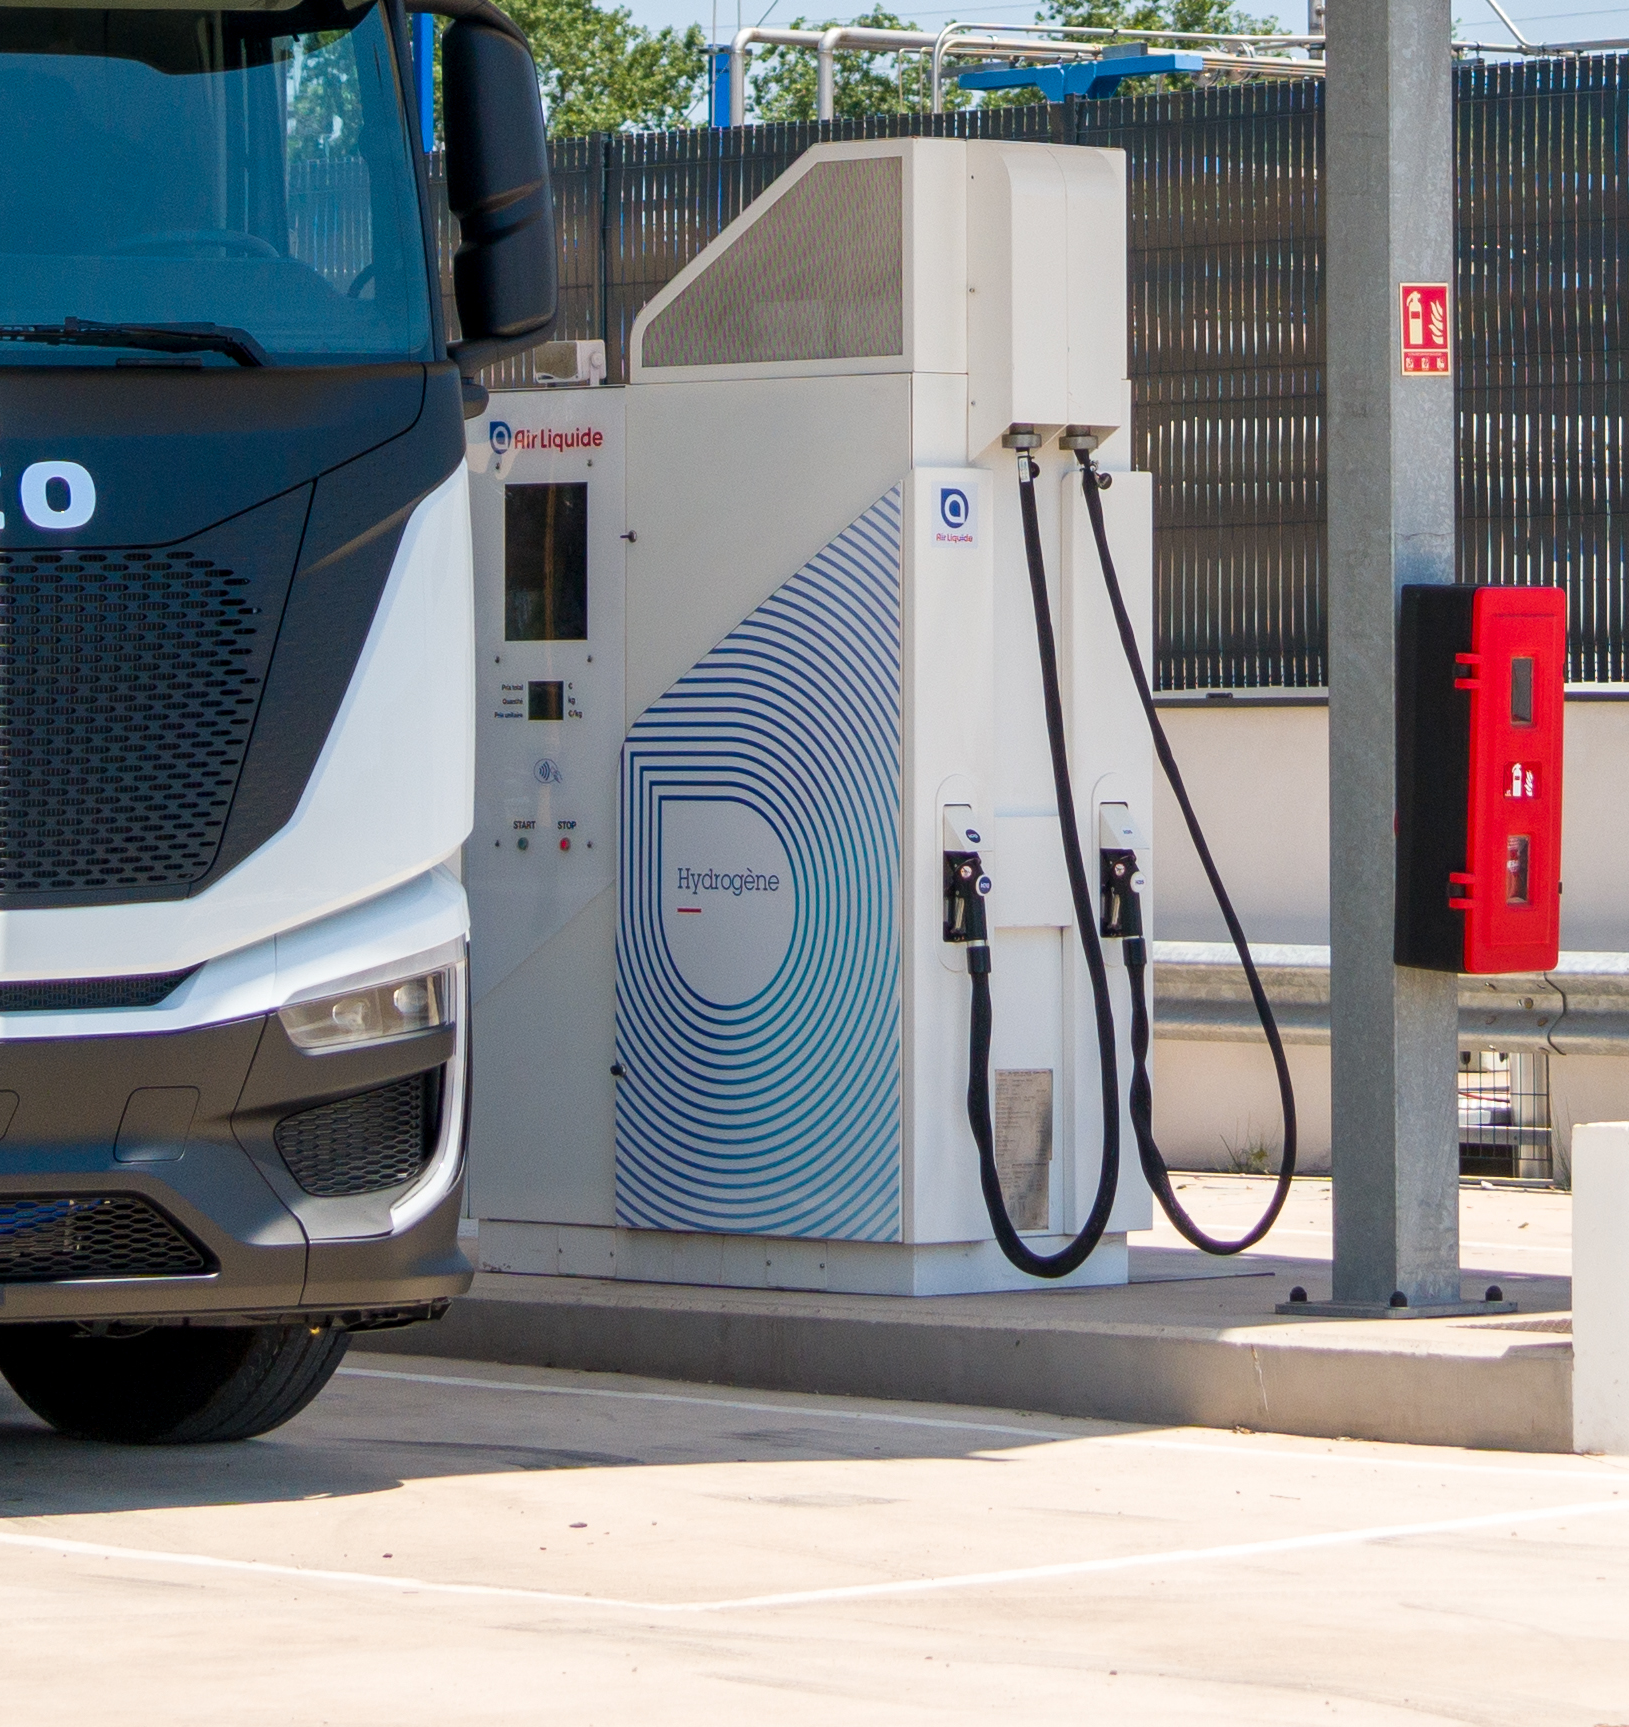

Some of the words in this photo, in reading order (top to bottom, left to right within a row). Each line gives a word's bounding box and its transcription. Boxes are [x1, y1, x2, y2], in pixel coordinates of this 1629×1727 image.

[514, 429, 538, 449] Air
[540, 426, 603, 452] Liquide
[935, 533, 946, 542] Air
[947, 533, 973, 543] Liquide
[513, 820, 536, 830] START
[557, 820, 577, 830] STOP
[677, 867, 780, 896] Hydrogène
